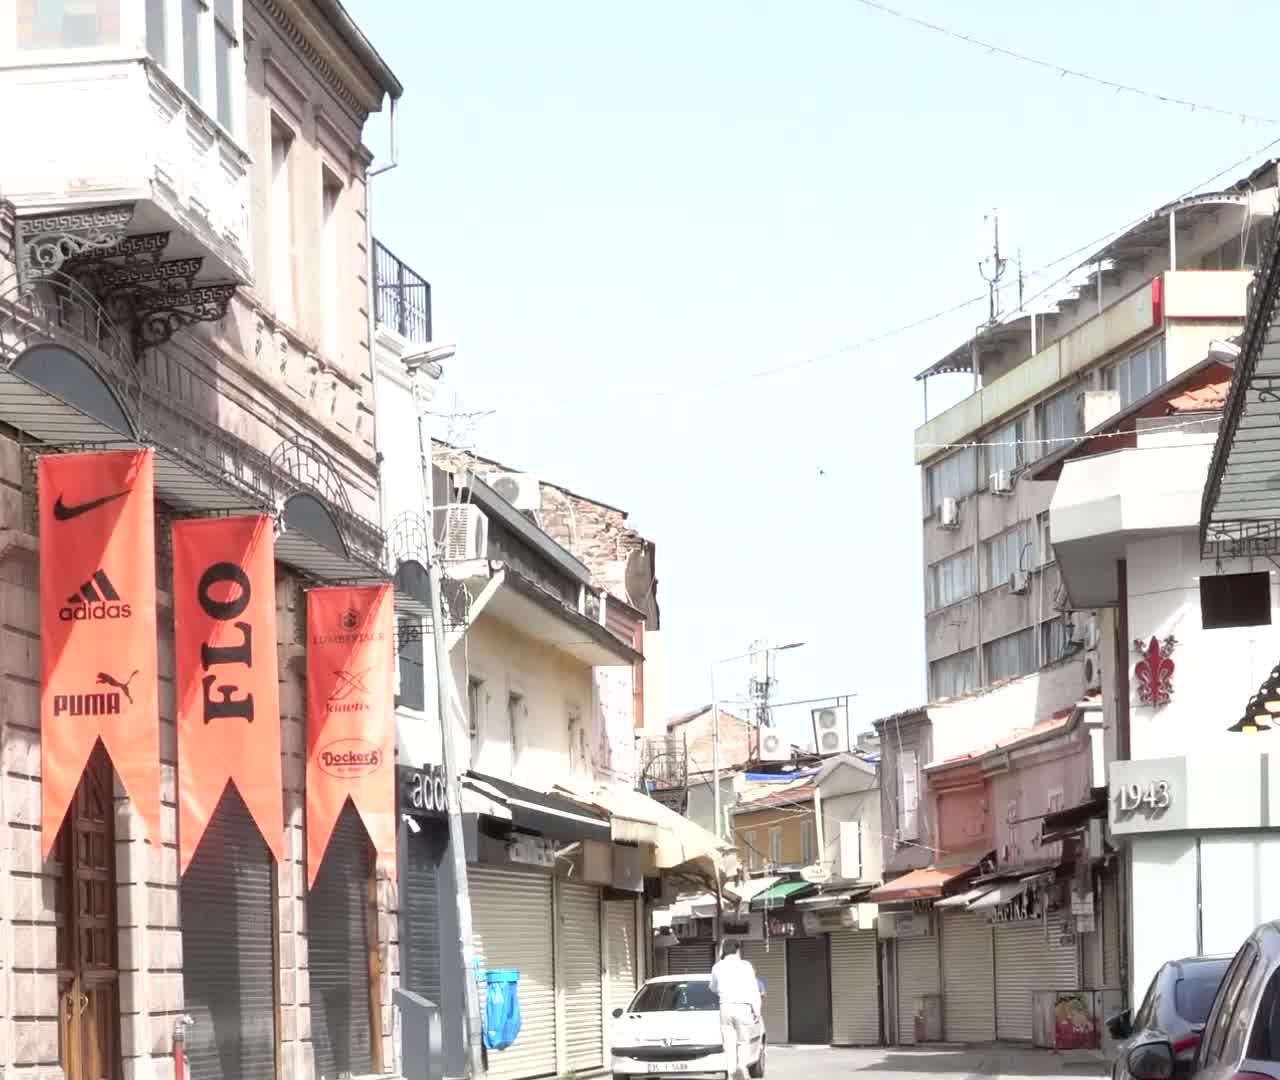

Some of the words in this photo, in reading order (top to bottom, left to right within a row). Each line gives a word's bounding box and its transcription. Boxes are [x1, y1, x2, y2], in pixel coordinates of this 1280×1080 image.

[58, 600, 132, 622] adidas
[197, 561, 254, 725] FLO
[53, 692, 121, 717] PUMA
[1119, 779, 1171, 811] 1943
